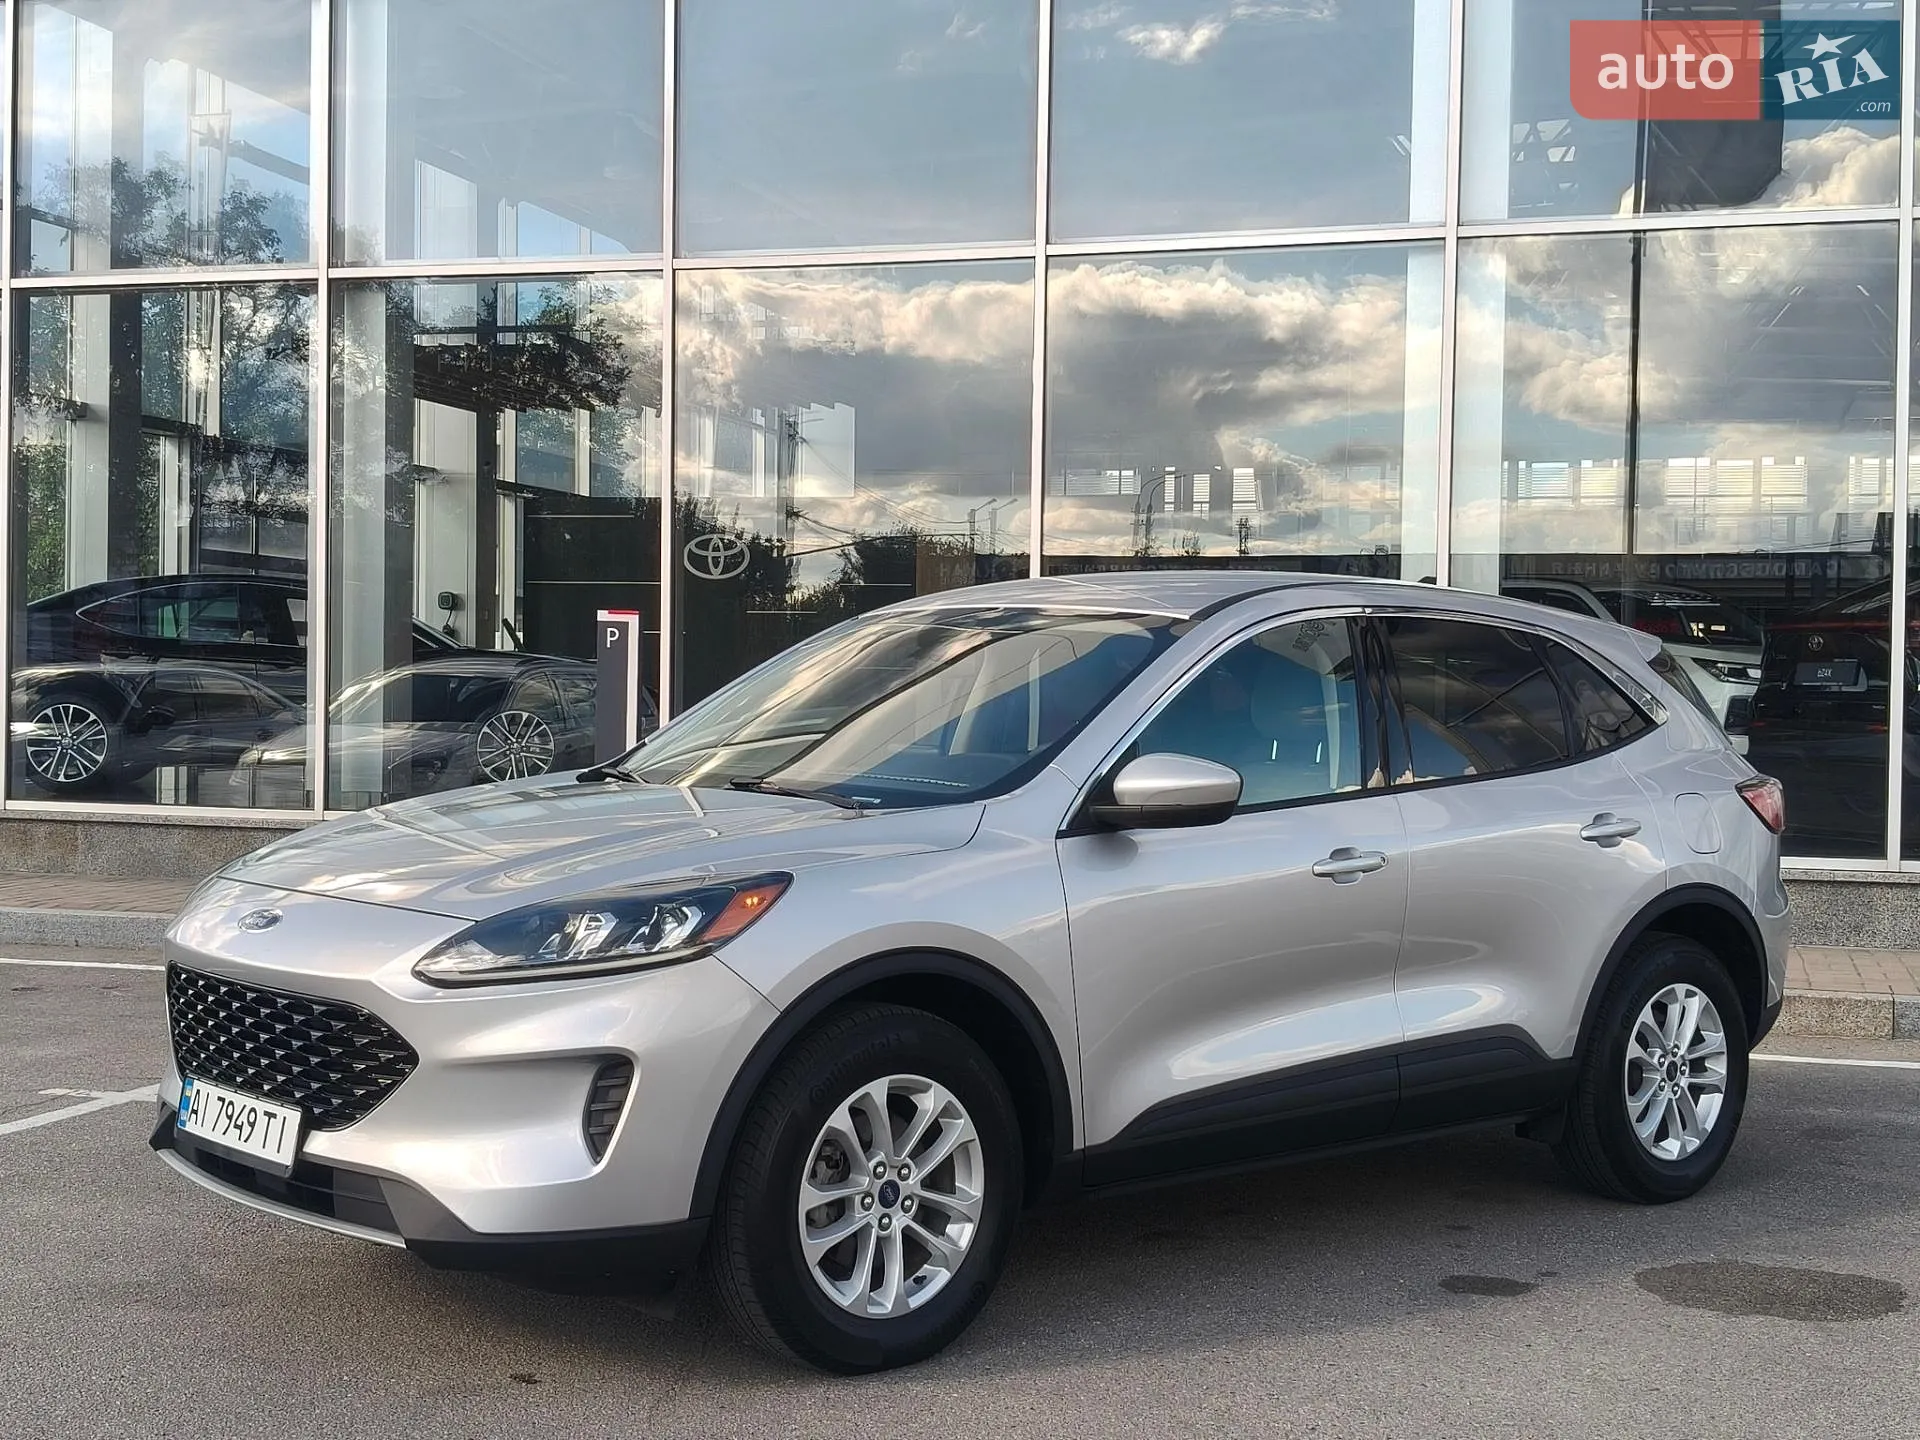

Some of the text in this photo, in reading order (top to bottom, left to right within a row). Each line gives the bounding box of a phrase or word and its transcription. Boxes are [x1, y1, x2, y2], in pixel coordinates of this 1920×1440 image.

[606, 628, 619, 648] P
[188, 1088, 287, 1154] AI 7949 TI
